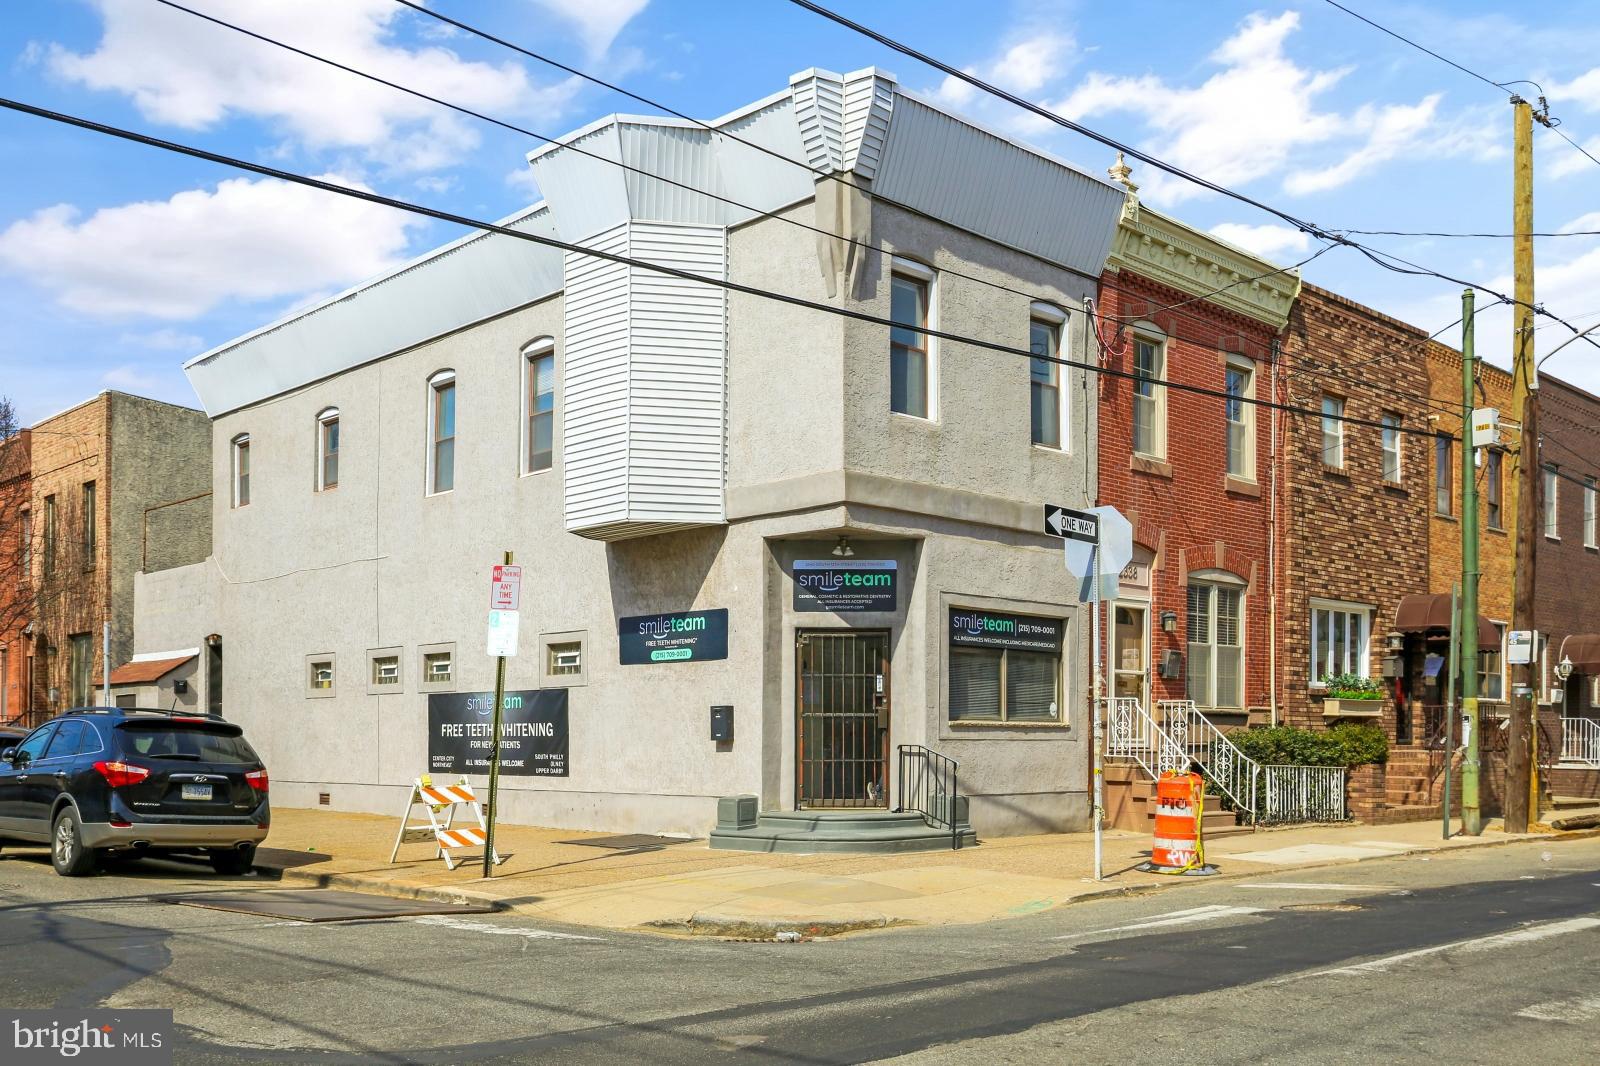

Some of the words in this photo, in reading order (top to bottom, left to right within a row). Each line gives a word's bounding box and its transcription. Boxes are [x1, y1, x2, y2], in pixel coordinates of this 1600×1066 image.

[1061, 516, 1076, 531] ONE
[1078, 520, 1094, 534] WAY
[494, 569, 502, 578] NO
[799, 571, 891, 586] smileteam
[499, 591, 513, 599] TIME
[639, 616, 706, 635] smileteam
[953, 614, 1014, 633] smileteam
[1018, 624, 1031, 634] (215)
[1031, 625, 1055, 634] 709-0001
[441, 723, 463, 737] FREE
[465, 723, 494, 737] TEETH
[470, 740, 482, 749] FOR
[498, 740, 521, 749] ATIENTS
[465, 759, 474, 767] ALL
